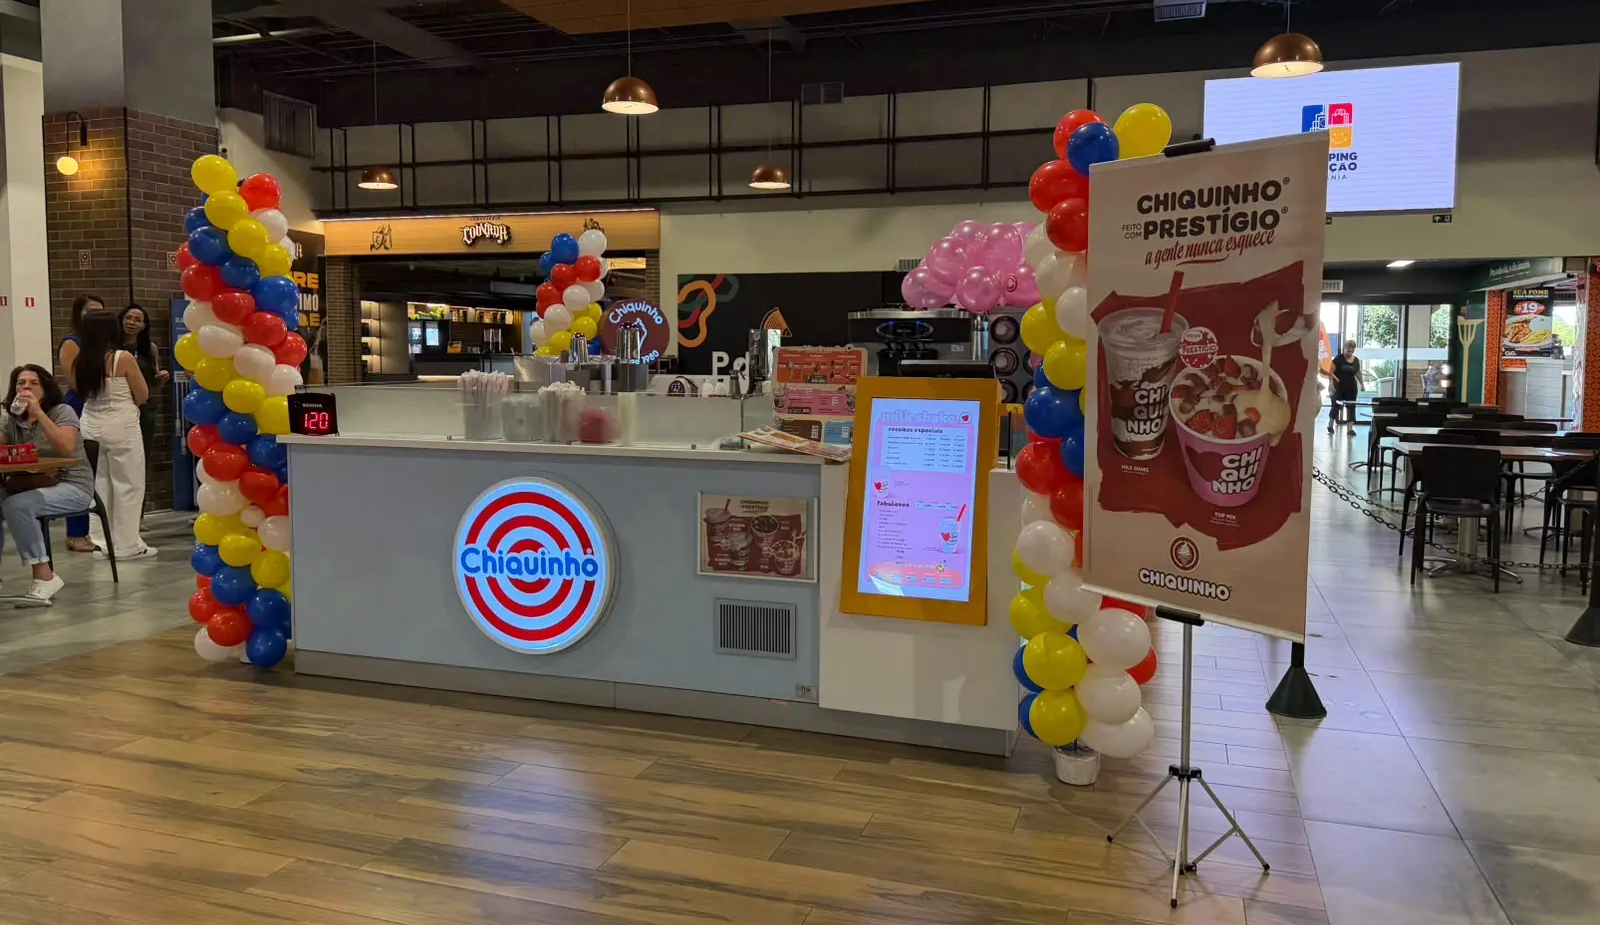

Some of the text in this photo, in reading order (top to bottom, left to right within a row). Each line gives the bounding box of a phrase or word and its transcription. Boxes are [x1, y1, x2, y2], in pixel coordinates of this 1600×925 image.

[1122, 223, 1142, 232] FEITO
[1124, 231, 1142, 239] COM
[1145, 229, 1275, 269] a gente nunca esquece
[609, 301, 663, 325] Chiquinho
[641, 350, 660, 364] 1980
[1134, 385, 1167, 404] CHI
[304, 412, 329, 429] 120
[1125, 419, 1163, 435] NHO
[1222, 446, 1263, 468] CHI
[1220, 461, 1258, 481] QUI
[1211, 477, 1256, 494] NHO
[461, 547, 598, 577] Chiquinho
